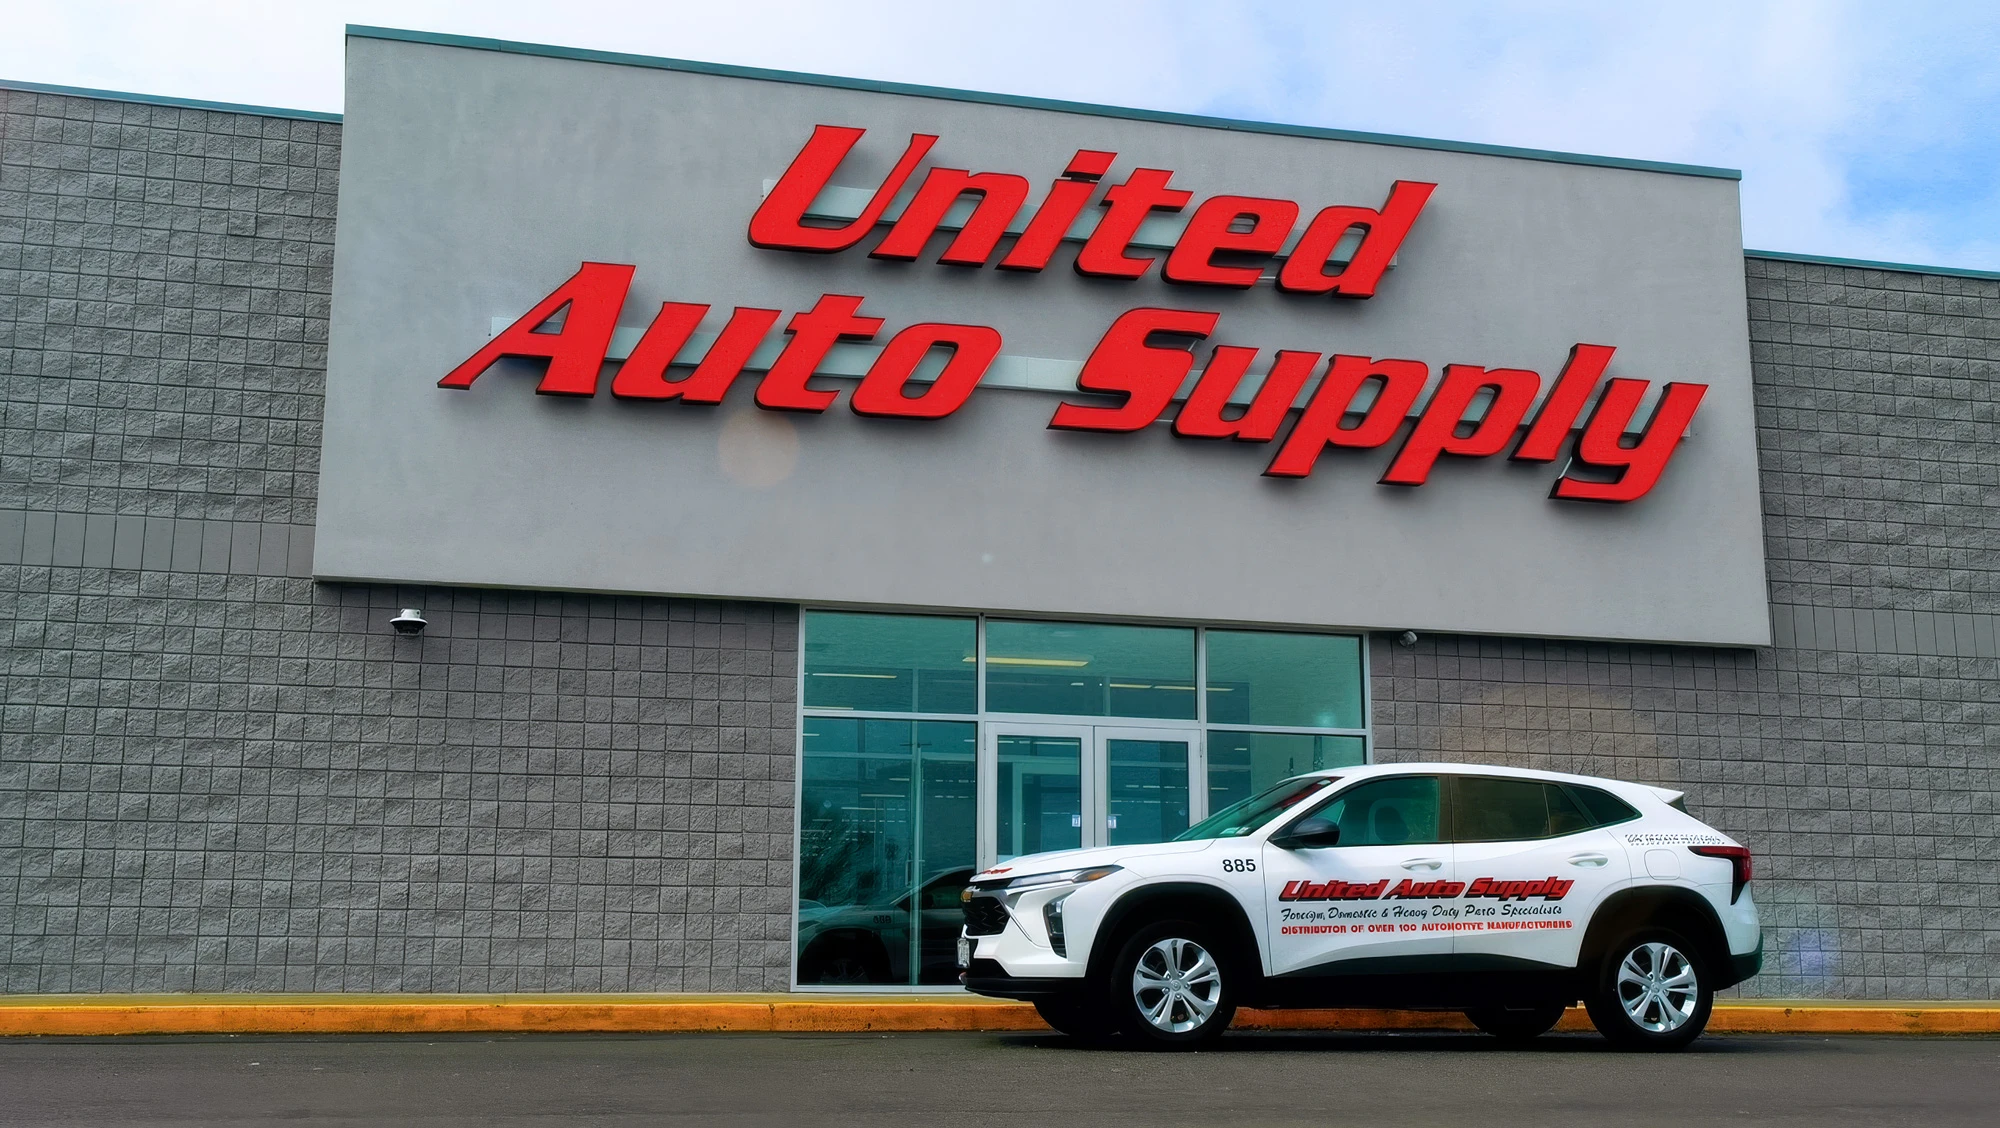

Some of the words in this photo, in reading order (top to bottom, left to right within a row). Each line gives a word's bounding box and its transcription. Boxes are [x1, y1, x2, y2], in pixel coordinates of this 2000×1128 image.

[747, 124, 1437, 300] United
[437, 261, 1003, 419] Auto
[1046, 307, 1708, 503] Supply
[1222, 859, 1256, 873] 885
[1278, 879, 1390, 901] United
[1381, 878, 1466, 900] Auto
[1464, 876, 1575, 901] Supply
[1328, 907, 1377, 919] Domestic
[1432, 905, 1459, 919] Duty
[1465, 904, 1496, 917] Parts
[1501, 904, 1562, 917] Specialists
[1281, 926, 1346, 934] DISTRIBUTOR
[1351, 925, 1364, 933] OF
[1368, 924, 1394, 932] OVER
[1422, 923, 1484, 931] AUTOMOTIVE
[1487, 921, 1573, 930] MANUFACTURERS
